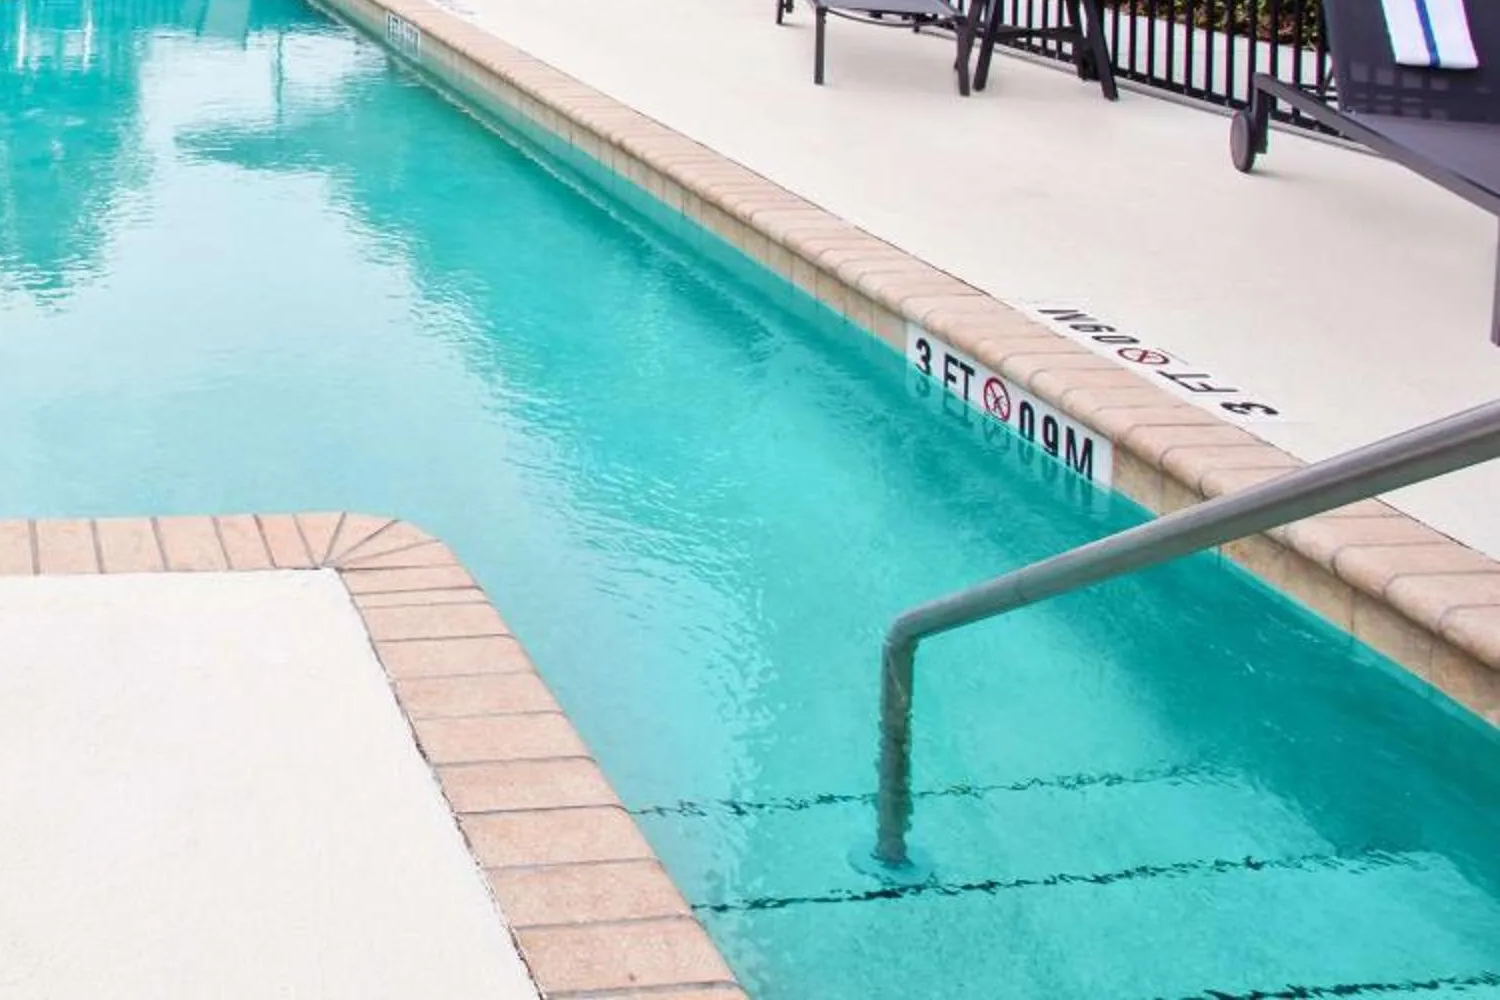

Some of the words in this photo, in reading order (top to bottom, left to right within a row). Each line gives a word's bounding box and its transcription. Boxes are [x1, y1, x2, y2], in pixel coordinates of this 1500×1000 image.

[915, 337, 932, 377] 3
[943, 351, 976, 402] FT
[1156, 369, 1240, 394] FT
[1219, 402, 1280, 426] 3
